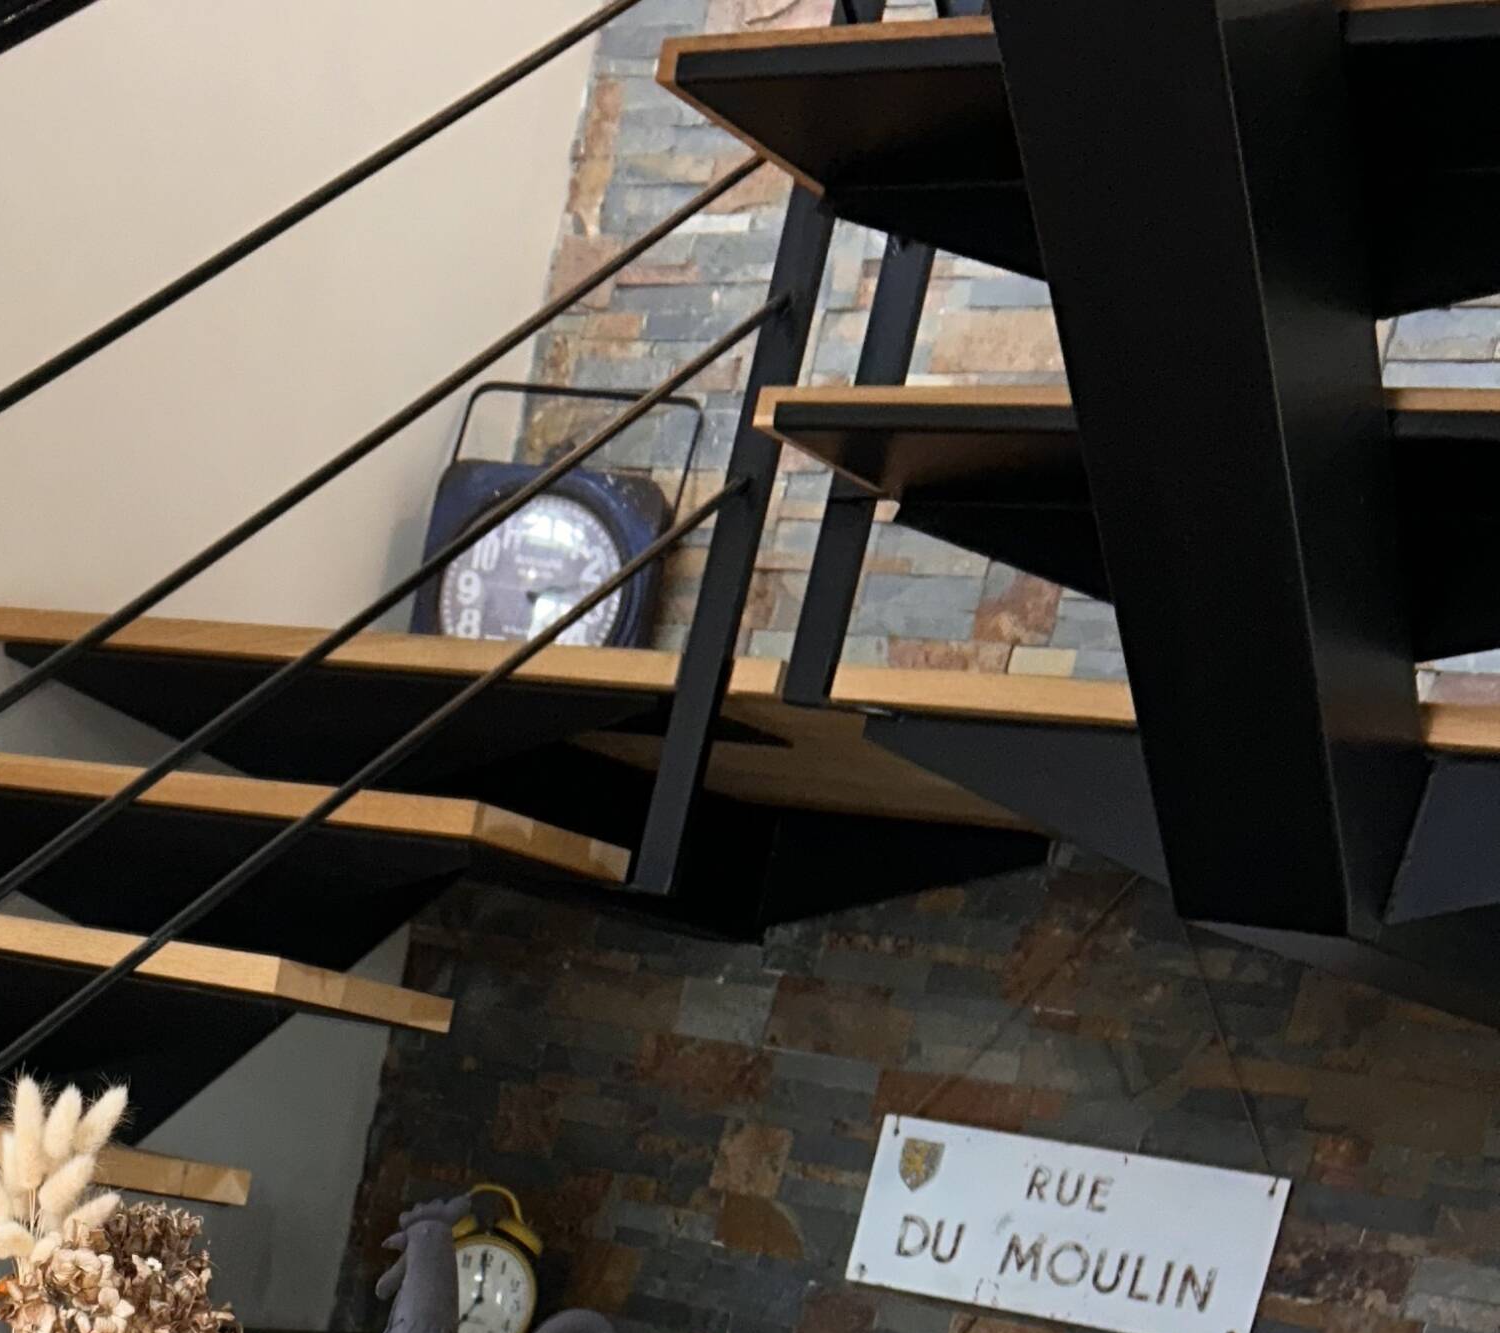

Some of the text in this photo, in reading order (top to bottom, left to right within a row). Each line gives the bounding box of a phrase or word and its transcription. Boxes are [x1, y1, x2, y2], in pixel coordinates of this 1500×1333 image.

[579, 546, 609, 585] 2
[456, 569, 482, 605] 9
[457, 608, 482, 640] 8
[1026, 1165, 1115, 1213] RUE
[895, 1214, 1219, 1314] DU MOULIN
